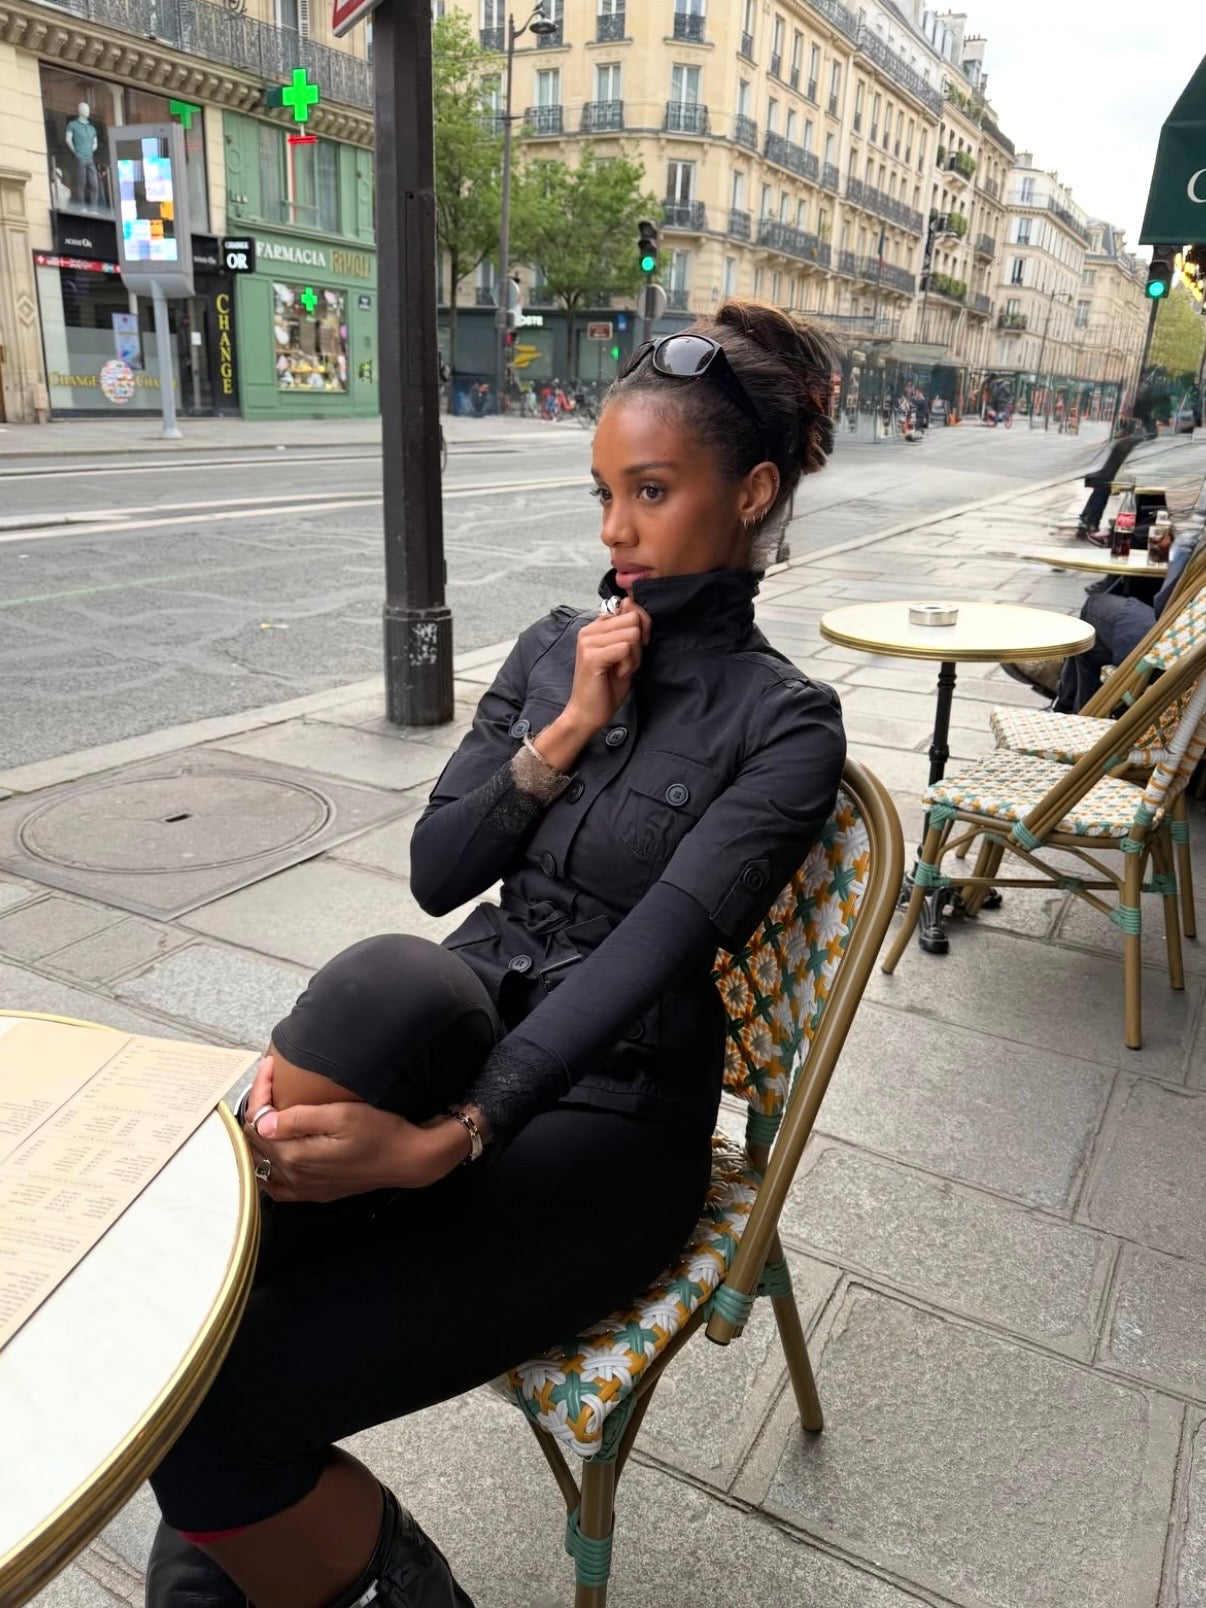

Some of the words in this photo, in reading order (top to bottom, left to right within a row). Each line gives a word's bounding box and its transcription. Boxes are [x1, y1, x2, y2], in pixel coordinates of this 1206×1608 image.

[226, 252, 249, 269] OR
[256, 241, 326, 268] FARMACIA
[216, 294, 232, 394] CHANGE
